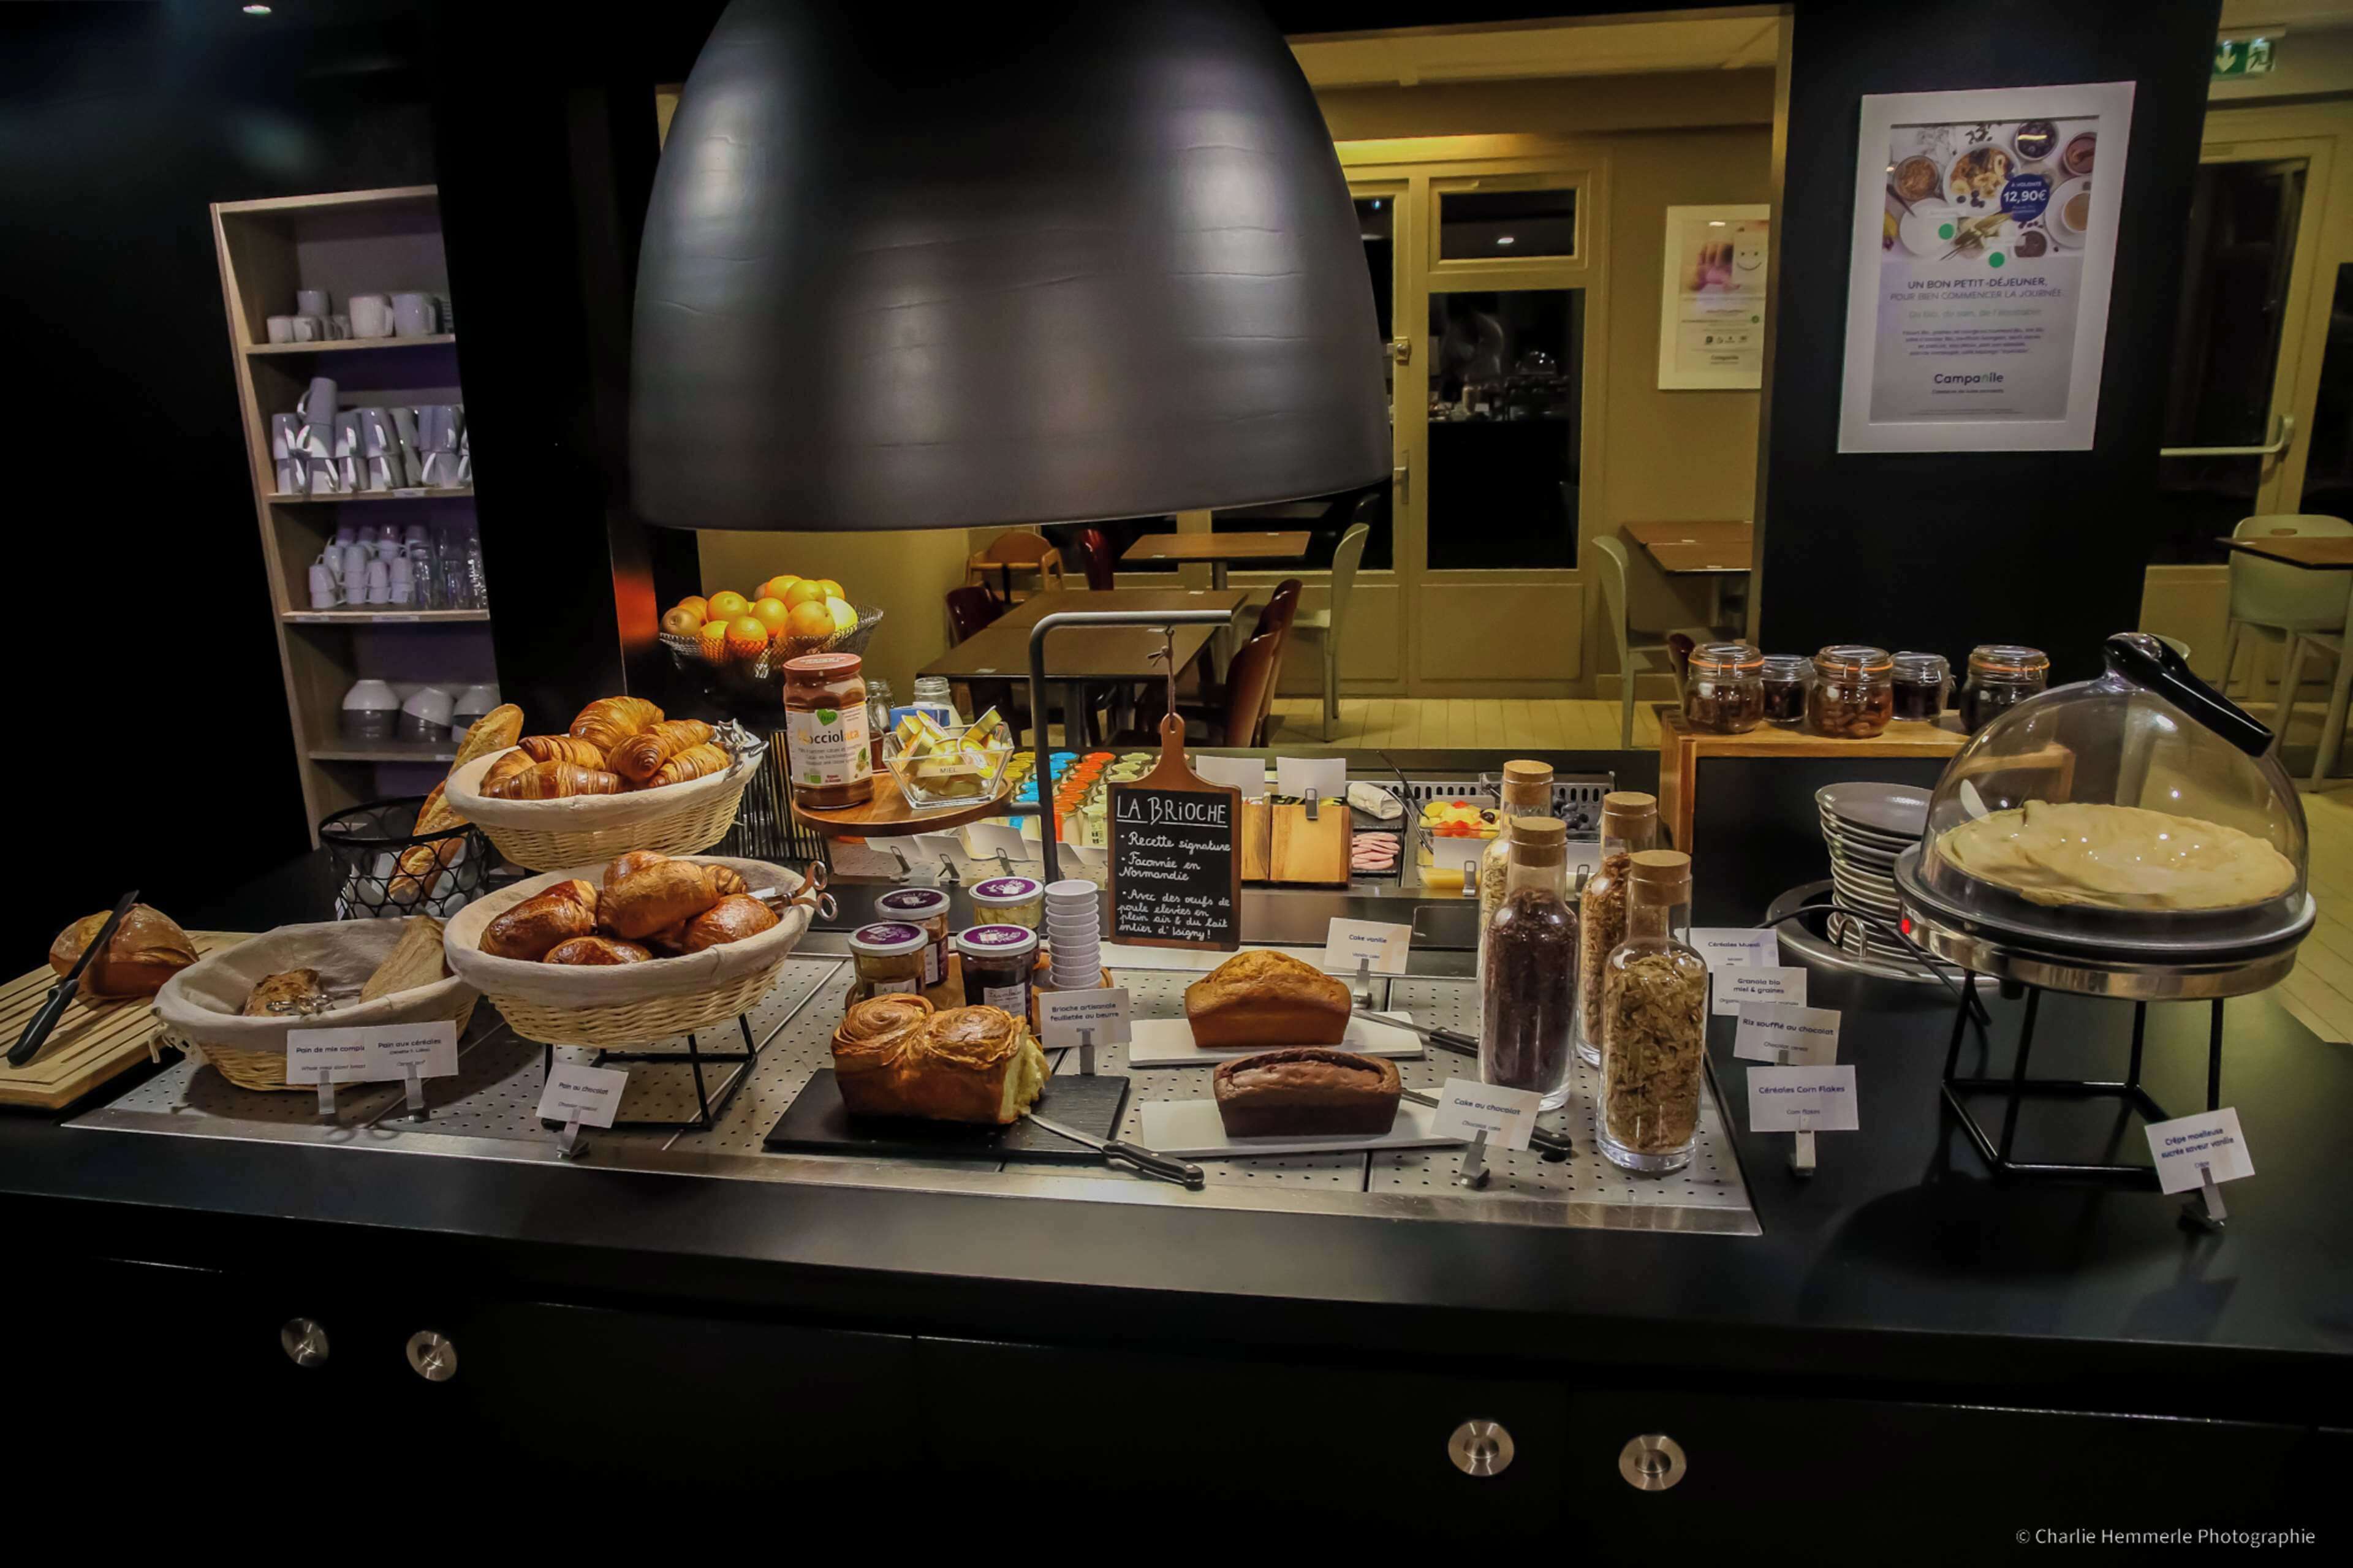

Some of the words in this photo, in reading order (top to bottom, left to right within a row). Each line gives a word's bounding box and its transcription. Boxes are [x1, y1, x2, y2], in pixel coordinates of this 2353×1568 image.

[2003, 189, 2047, 204] 12,90€
[1927, 280, 1950, 289] BON
[1934, 372, 2004, 386] Campanile
[1116, 795, 1141, 819] LA
[1128, 831, 1175, 847] Recette
[1178, 839, 1231, 855] signature
[1183, 862, 1201, 870] en
[1118, 867, 1190, 881] Normandie
[1127, 889, 1157, 901] Avec
[1162, 893, 1181, 903] des
[1218, 897, 1230, 907] de
[1117, 903, 1149, 914] poule
[1119, 912, 1149, 923] plein
[1186, 917, 1202, 926] du
[1204, 918, 1229, 928] lait
[1080, 1002, 1116, 1011] artisanale
[1756, 1021, 1784, 1030] soufflé
[1798, 1026, 1834, 1036] chocolat
[558, 1081, 572, 1091] Pain
[582, 1086, 608, 1095] chocolat
[1454, 1097, 1473, 1107] Cake
[1487, 1104, 1521, 1115] chocolat
[2165, 1135, 2186, 1146] Crêpe
[2211, 1136, 2235, 1148] vanille
